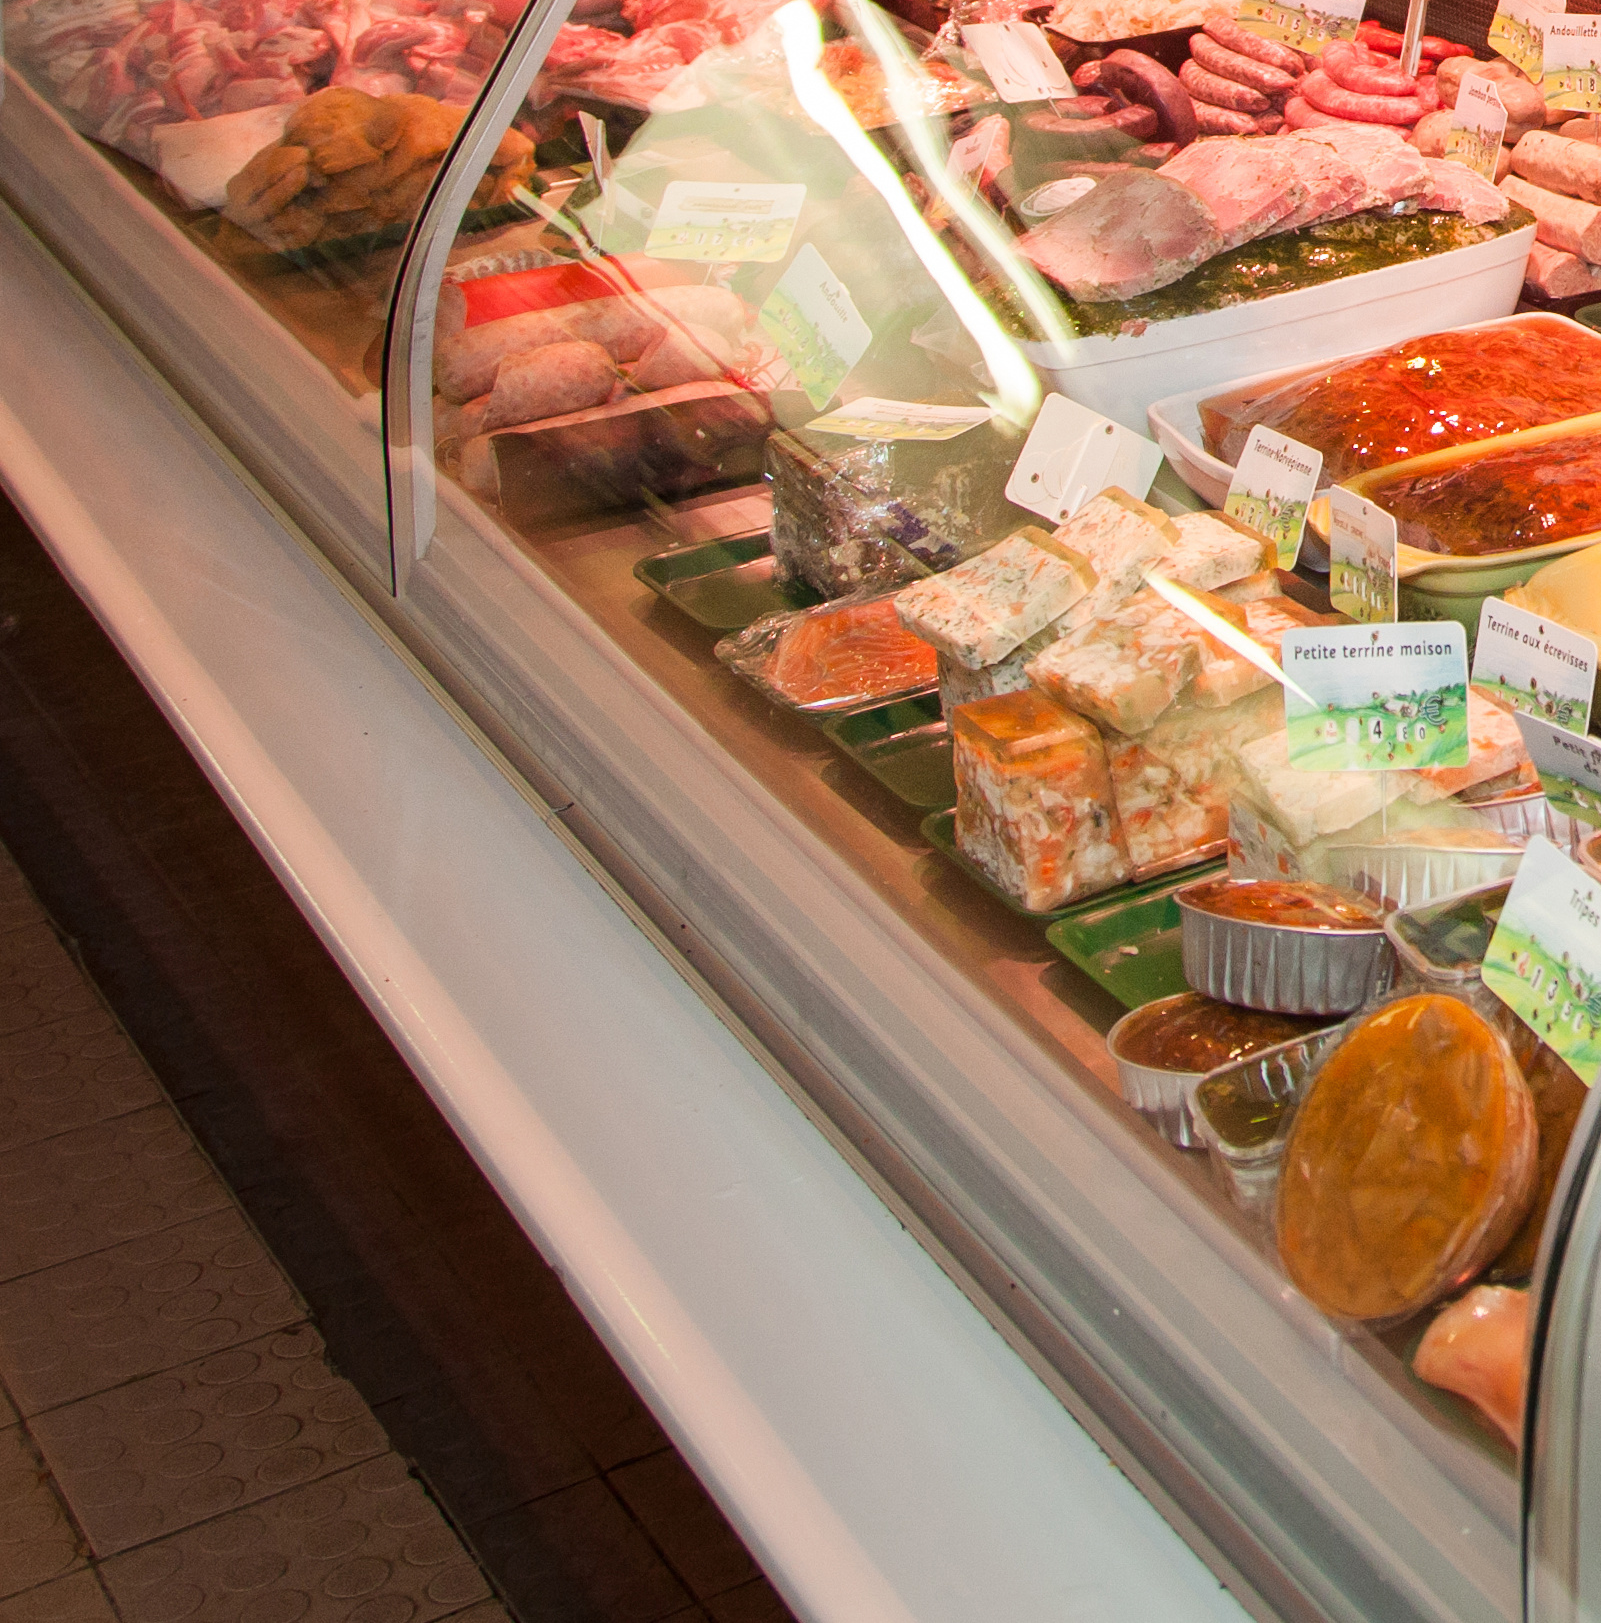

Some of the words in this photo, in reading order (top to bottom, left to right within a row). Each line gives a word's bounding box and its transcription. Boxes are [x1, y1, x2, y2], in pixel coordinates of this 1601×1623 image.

[1550, 25, 1598, 38] Andouillette
[819, 281, 849, 324] Andouille
[1294, 645, 1336, 661] Petite
[1343, 642, 1394, 659] terrine
[1400, 640, 1452, 656] maison
[1487, 615, 1519, 640] Terrine
[1522, 633, 1541, 651] aux
[1543, 643, 1588, 673] écrevisses
[1552, 735, 1586, 758] Petit
[1584, 763, 1599, 777] de
[1569, 889, 1601, 928] Tripes
